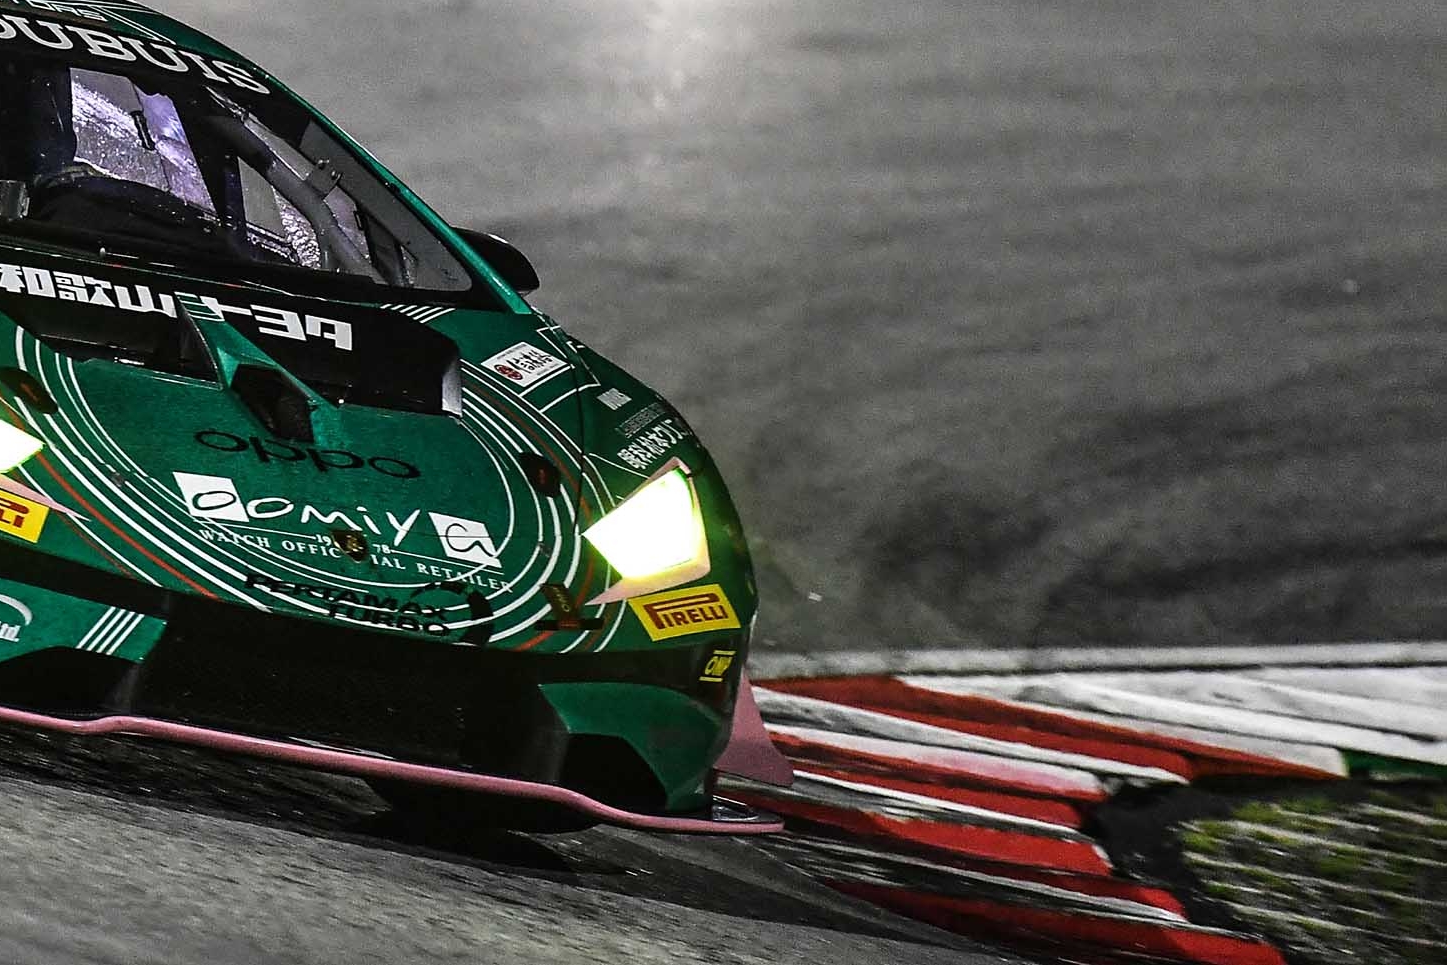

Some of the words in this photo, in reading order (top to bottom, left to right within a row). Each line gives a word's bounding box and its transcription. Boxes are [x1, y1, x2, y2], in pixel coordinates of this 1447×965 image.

[194, 428, 422, 480] oppo
[196, 527, 272, 550] WATCH
[416, 562, 514, 594] RETAILER
[246, 574, 449, 622] PERTAMAX
[329, 602, 450, 635] TURBO
[642, 592, 729, 630] PIRELLI
